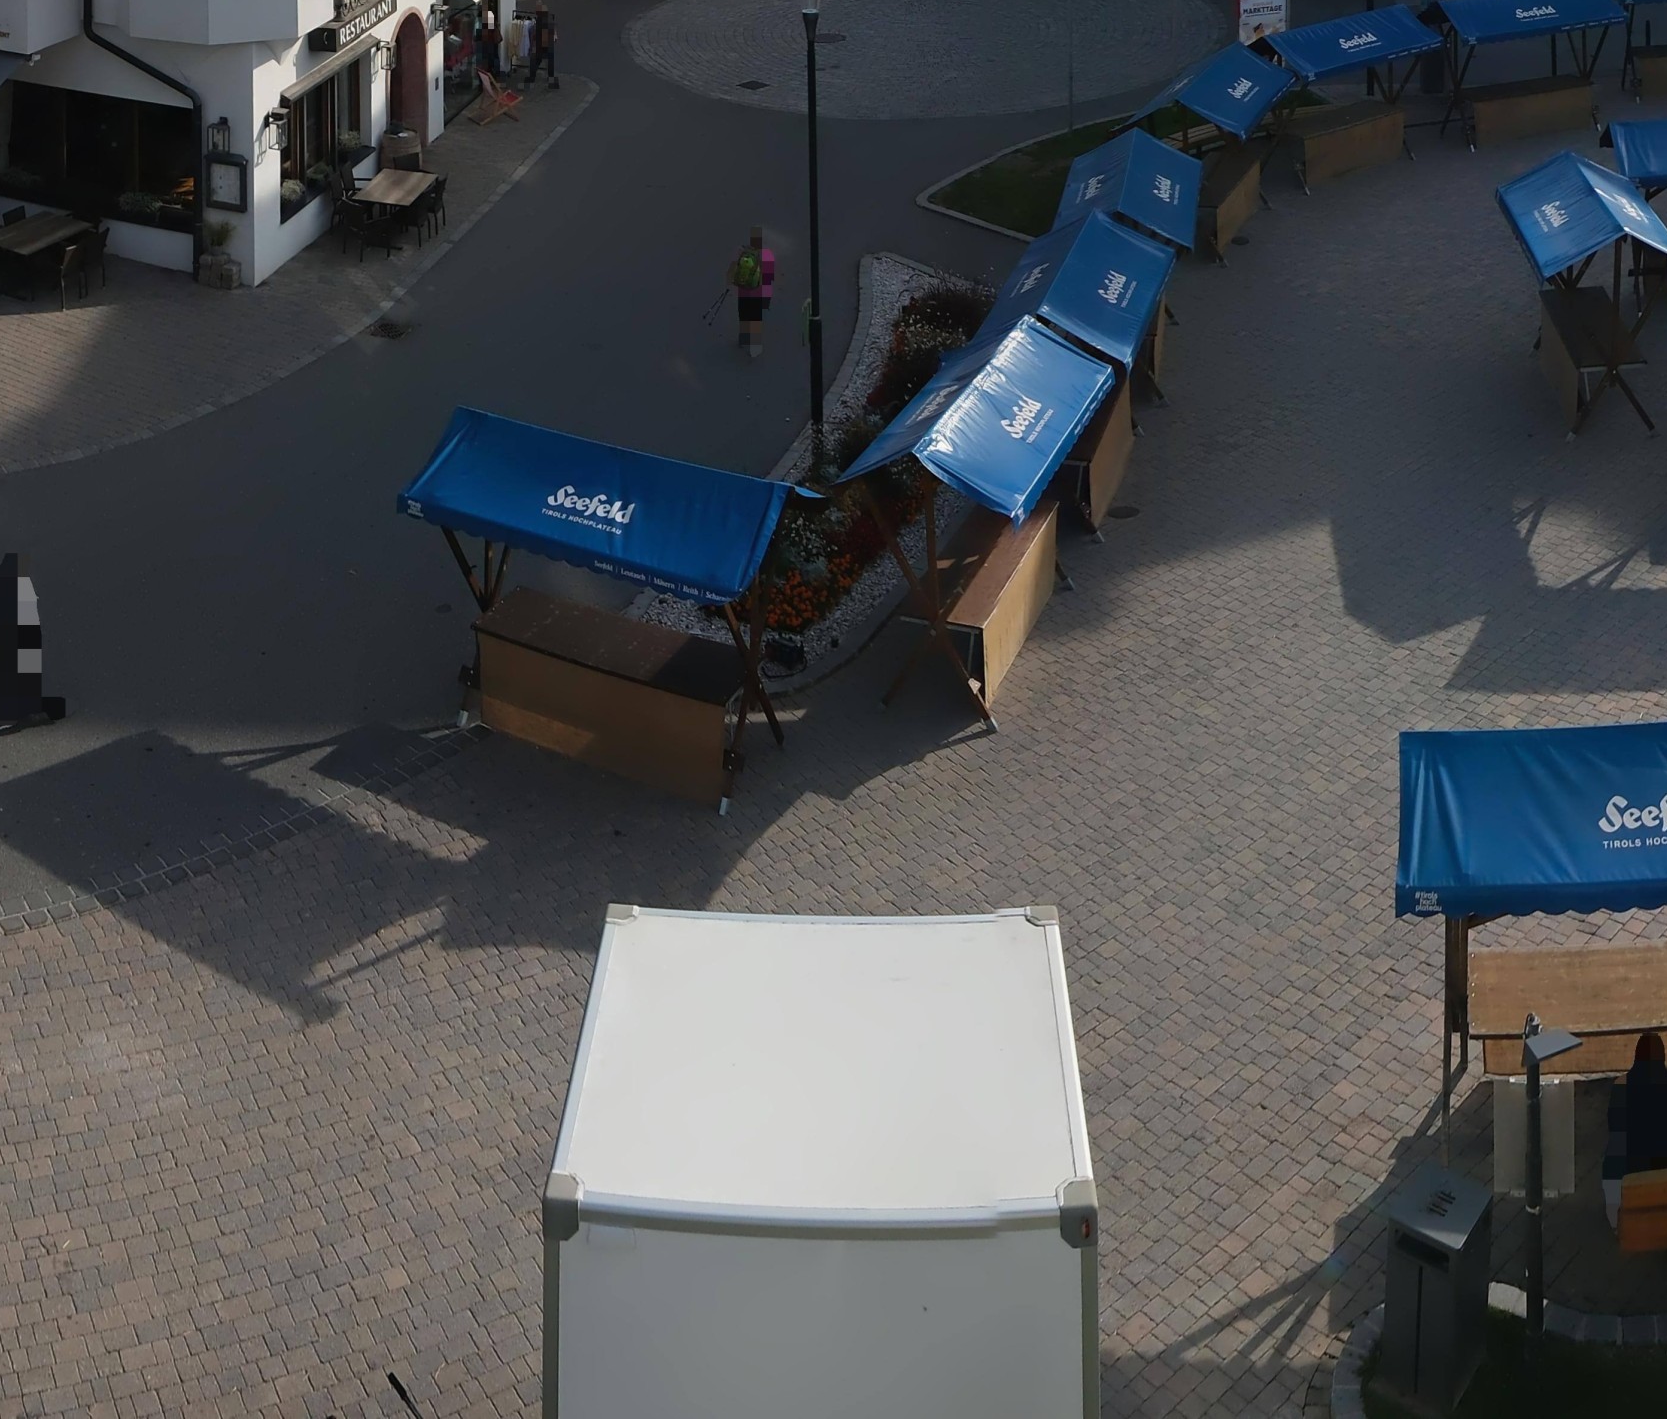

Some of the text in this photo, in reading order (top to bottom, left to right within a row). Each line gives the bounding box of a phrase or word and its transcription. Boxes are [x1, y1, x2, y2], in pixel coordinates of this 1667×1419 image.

[1242, 4, 1283, 15] MARKTTAGE
[1516, 5, 1556, 19] Seefeld
[1338, 32, 1378, 49] Seefeld
[1001, 393, 1042, 439] Seefeld
[547, 485, 636, 524] Seefeld
[541, 508, 622, 535] TIROLS HOCHPLATEAU
[1603, 838, 1641, 849] TIROLS
